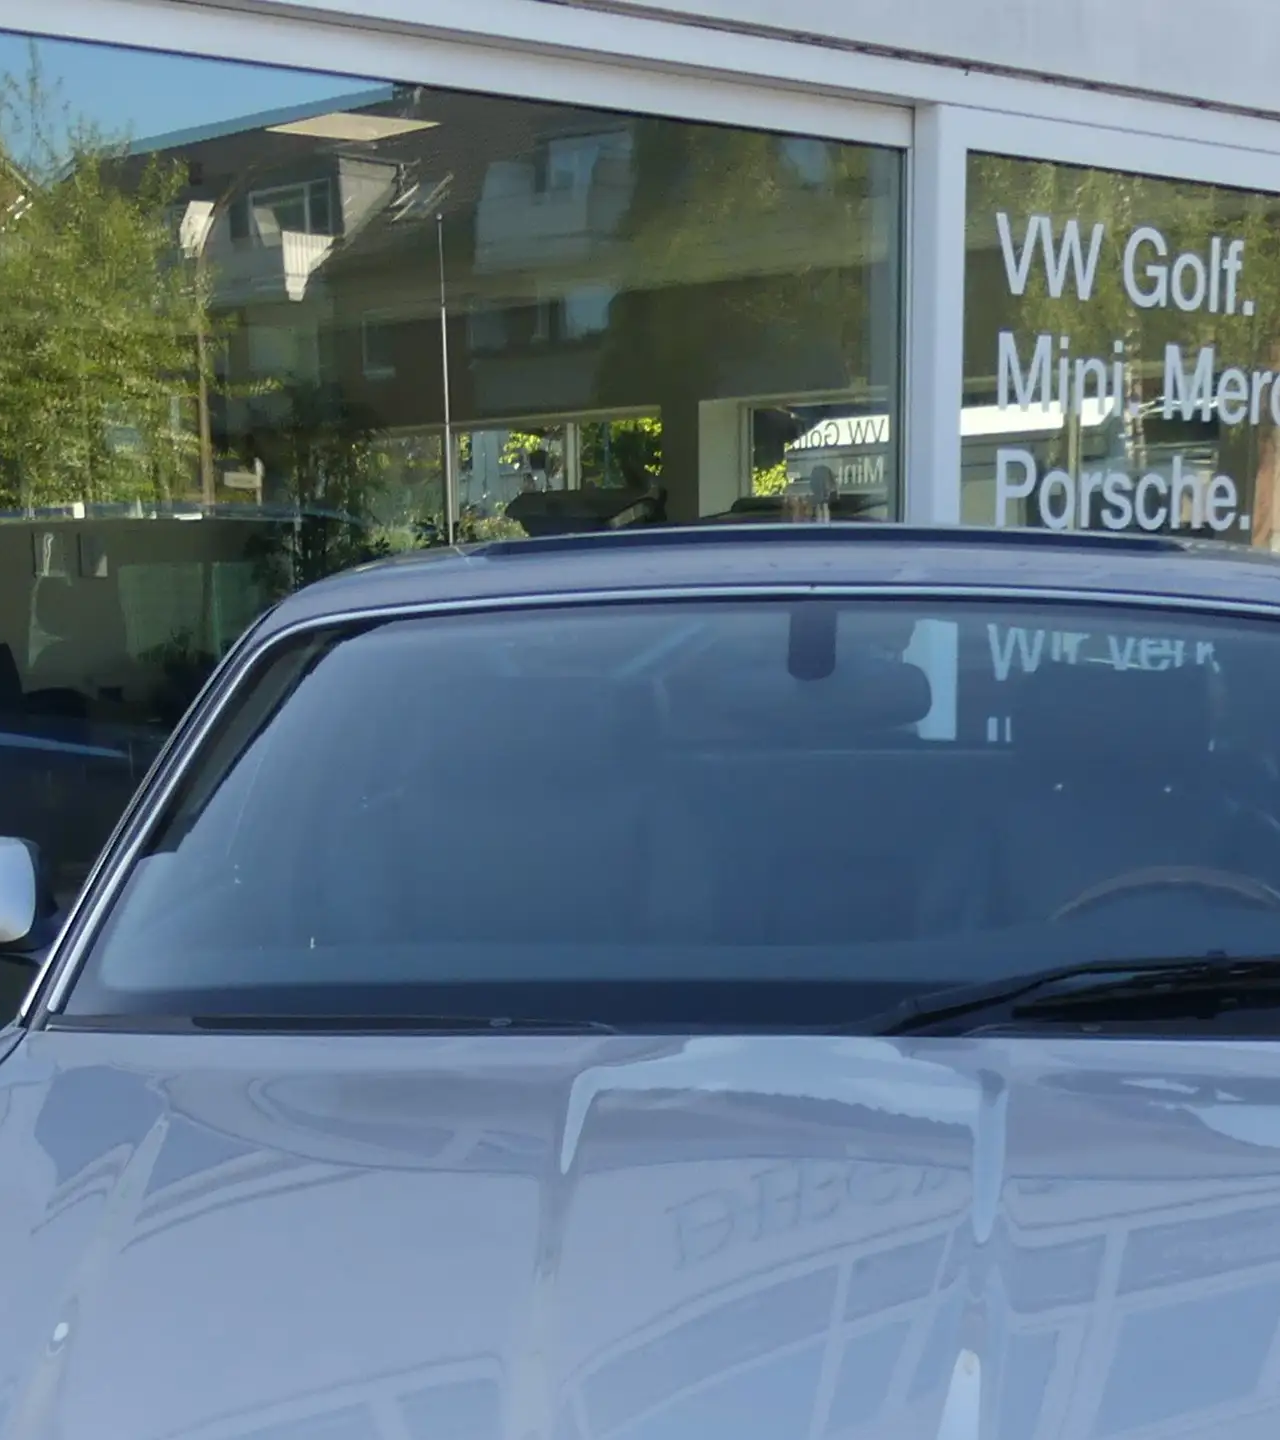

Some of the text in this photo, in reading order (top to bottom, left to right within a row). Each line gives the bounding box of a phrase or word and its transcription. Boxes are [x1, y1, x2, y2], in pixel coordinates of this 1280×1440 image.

[996, 212, 1255, 316] VW Golf.
[995, 448, 1251, 531] Porsche.
